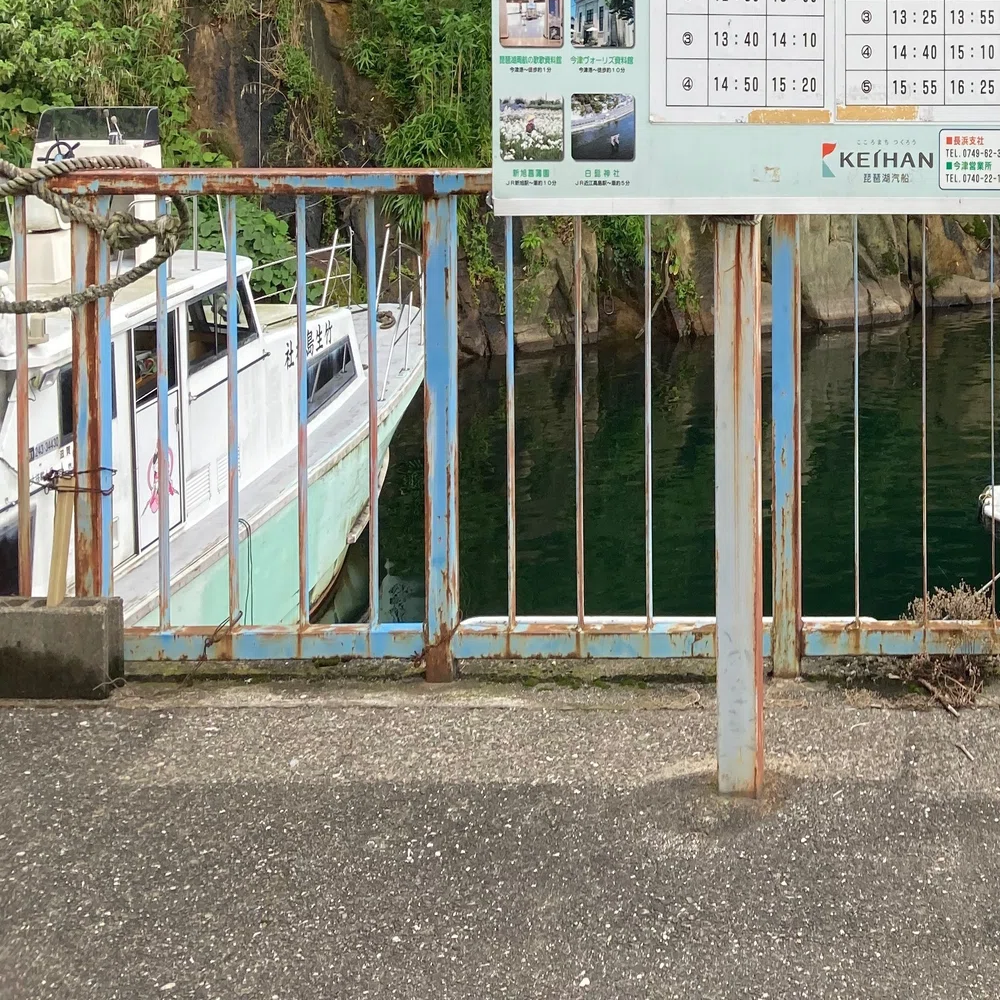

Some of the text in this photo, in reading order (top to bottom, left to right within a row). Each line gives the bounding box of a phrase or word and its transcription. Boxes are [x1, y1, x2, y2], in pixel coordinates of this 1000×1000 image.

[892, 10, 937, 25] 13:25
[950, 10, 995, 25] 13:55
[714, 31, 759, 46] 13:40
[772, 32, 817, 47] 14:10
[892, 45, 937, 60] 14:40
[950, 45, 995, 60] 15:10
[714, 77, 759, 92] 14:50
[772, 77, 817, 92] 15:20
[892, 80, 937, 95] 15:55
[950, 80, 995, 95] 16:25
[840, 149, 934, 168] KEIHAN
[863, 173, 910, 183] 琵琶湖汽船
